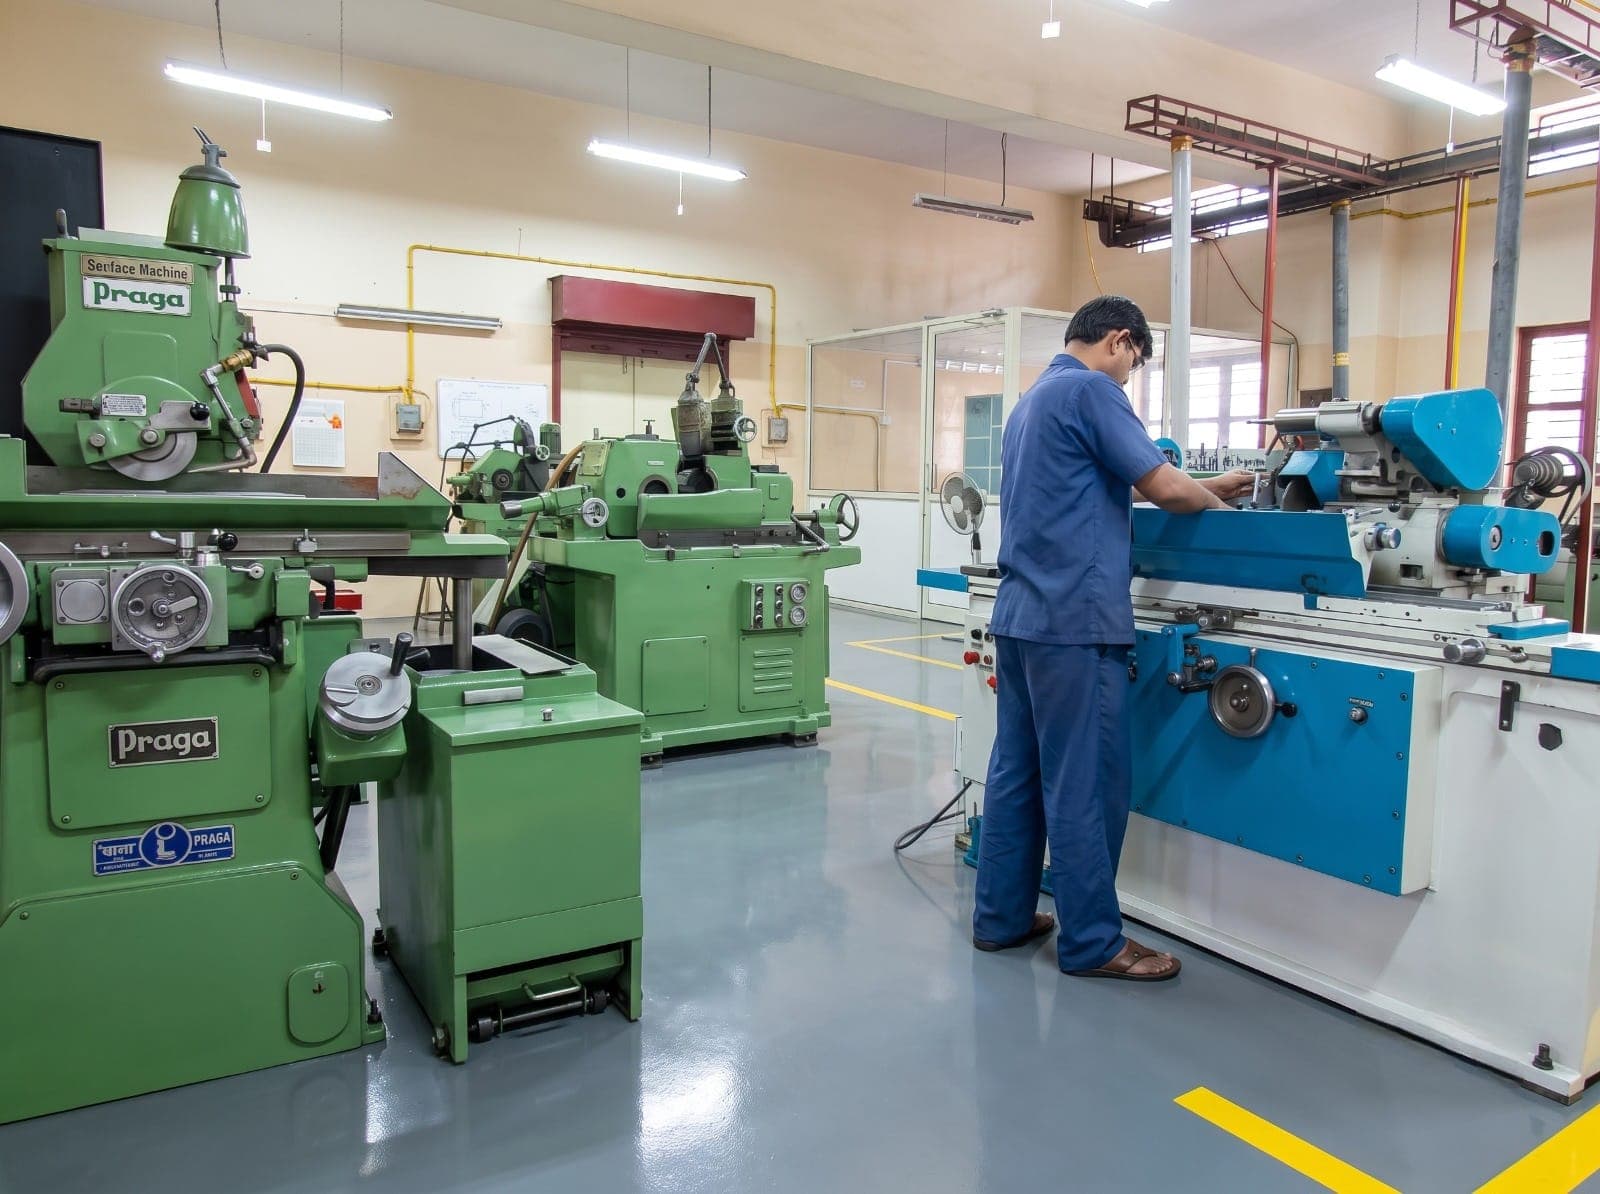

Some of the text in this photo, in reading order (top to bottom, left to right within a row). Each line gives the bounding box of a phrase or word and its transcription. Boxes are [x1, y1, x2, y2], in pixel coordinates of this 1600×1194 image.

[139, 263, 188, 280] Machine
[93, 281, 185, 311] Praga
[117, 729, 212, 760] Praga
[194, 831, 231, 847] PRAGA
